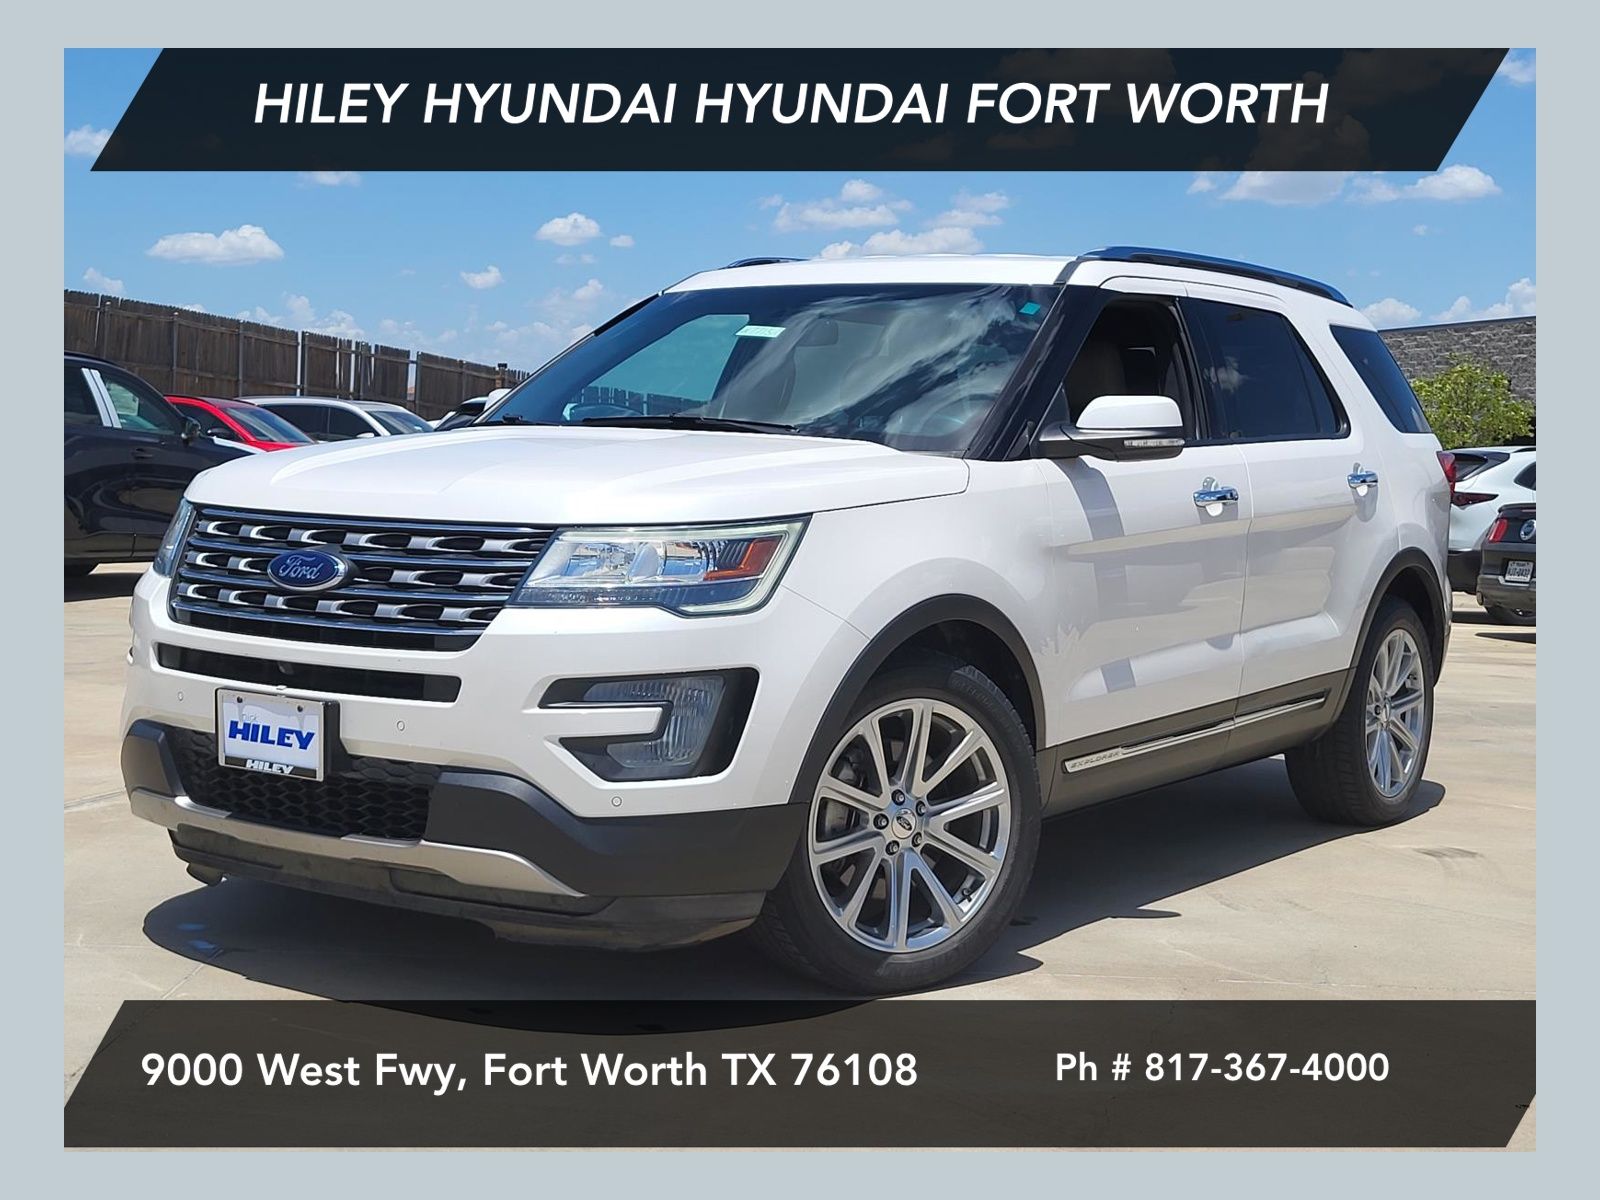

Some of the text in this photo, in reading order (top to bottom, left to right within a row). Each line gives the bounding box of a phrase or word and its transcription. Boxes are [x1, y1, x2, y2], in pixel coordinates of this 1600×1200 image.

[278, 554, 324, 580] Ford
[228, 720, 315, 750] HILEY
[245, 759, 295, 775] HILEY
